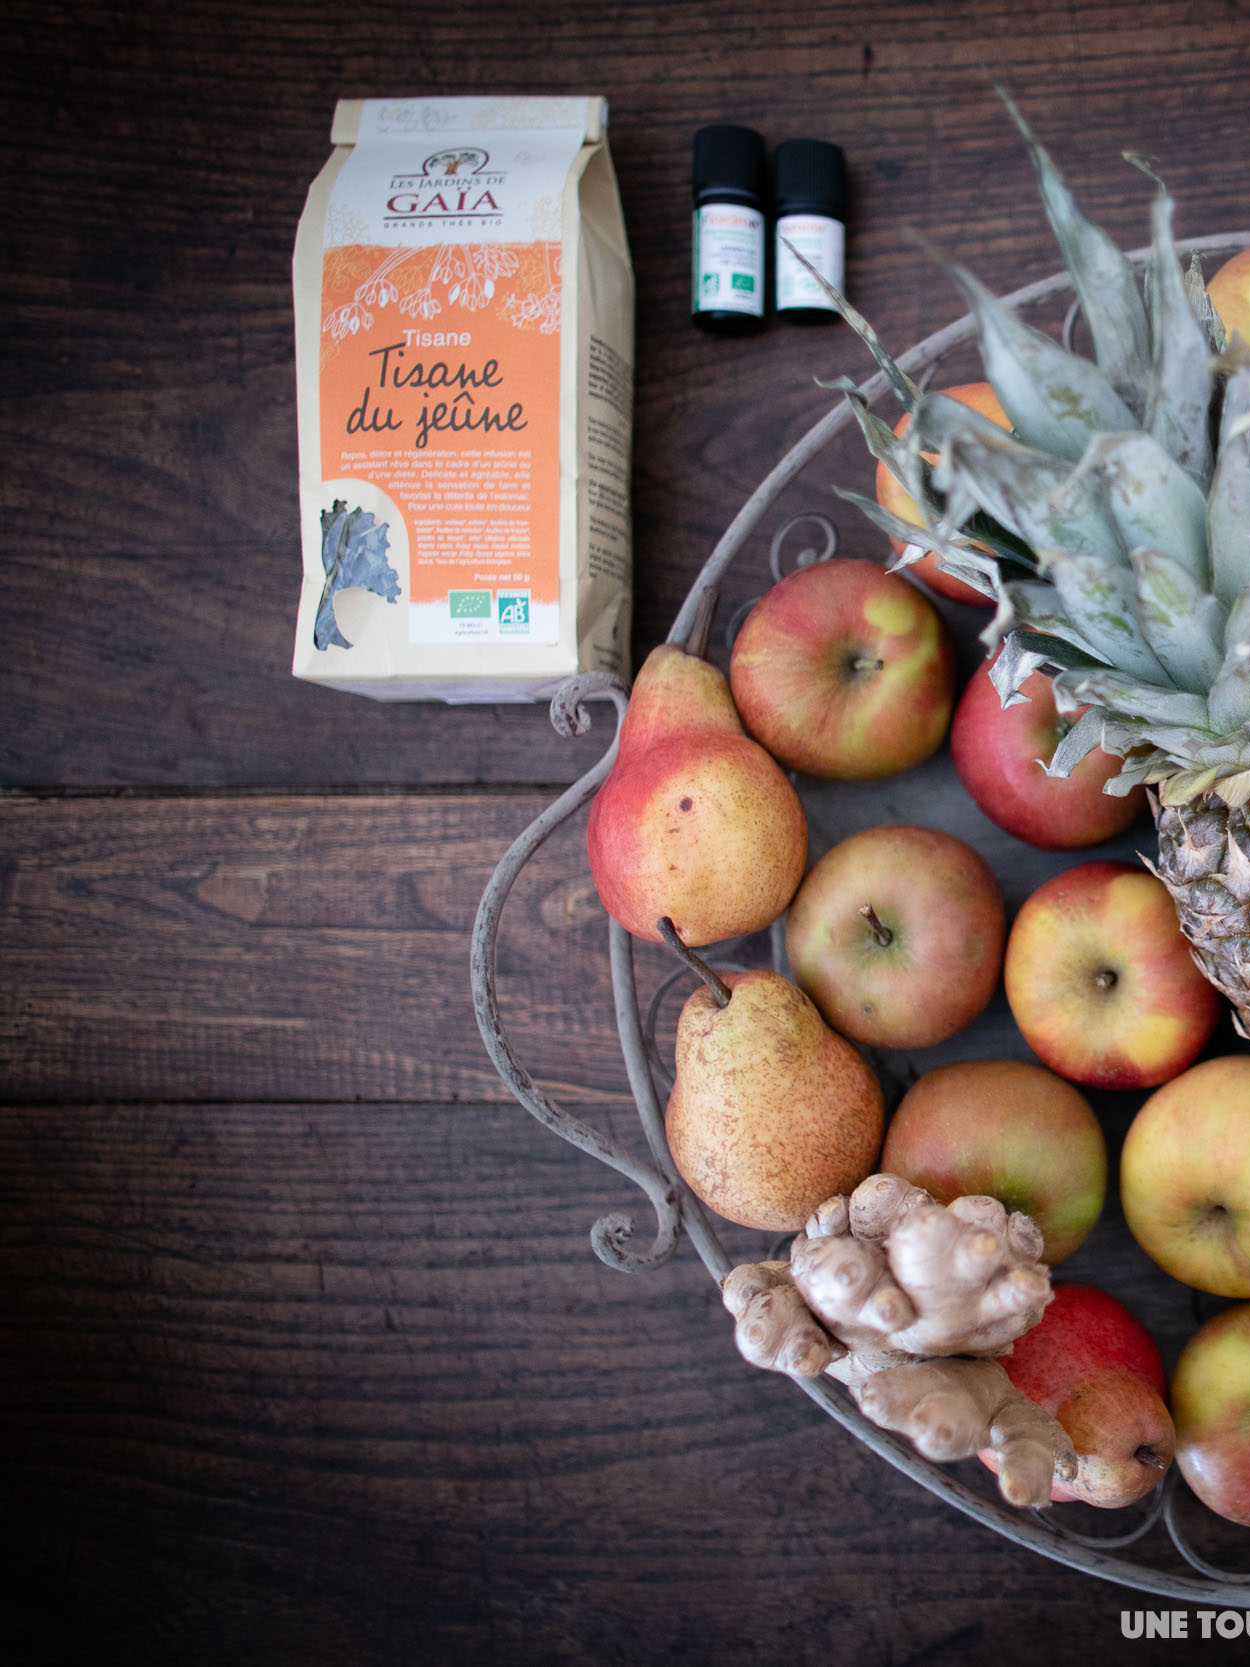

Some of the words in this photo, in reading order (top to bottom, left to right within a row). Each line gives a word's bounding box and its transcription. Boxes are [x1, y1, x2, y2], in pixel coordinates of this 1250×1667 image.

[419, 178, 480, 189] JARDINS
[486, 176, 505, 185] DE
[386, 186, 499, 214] GAÏA
[403, 329, 472, 347] Tisane
[368, 342, 504, 388] Tisane
[346, 386, 403, 434] du
[415, 390, 528, 449] jeûne
